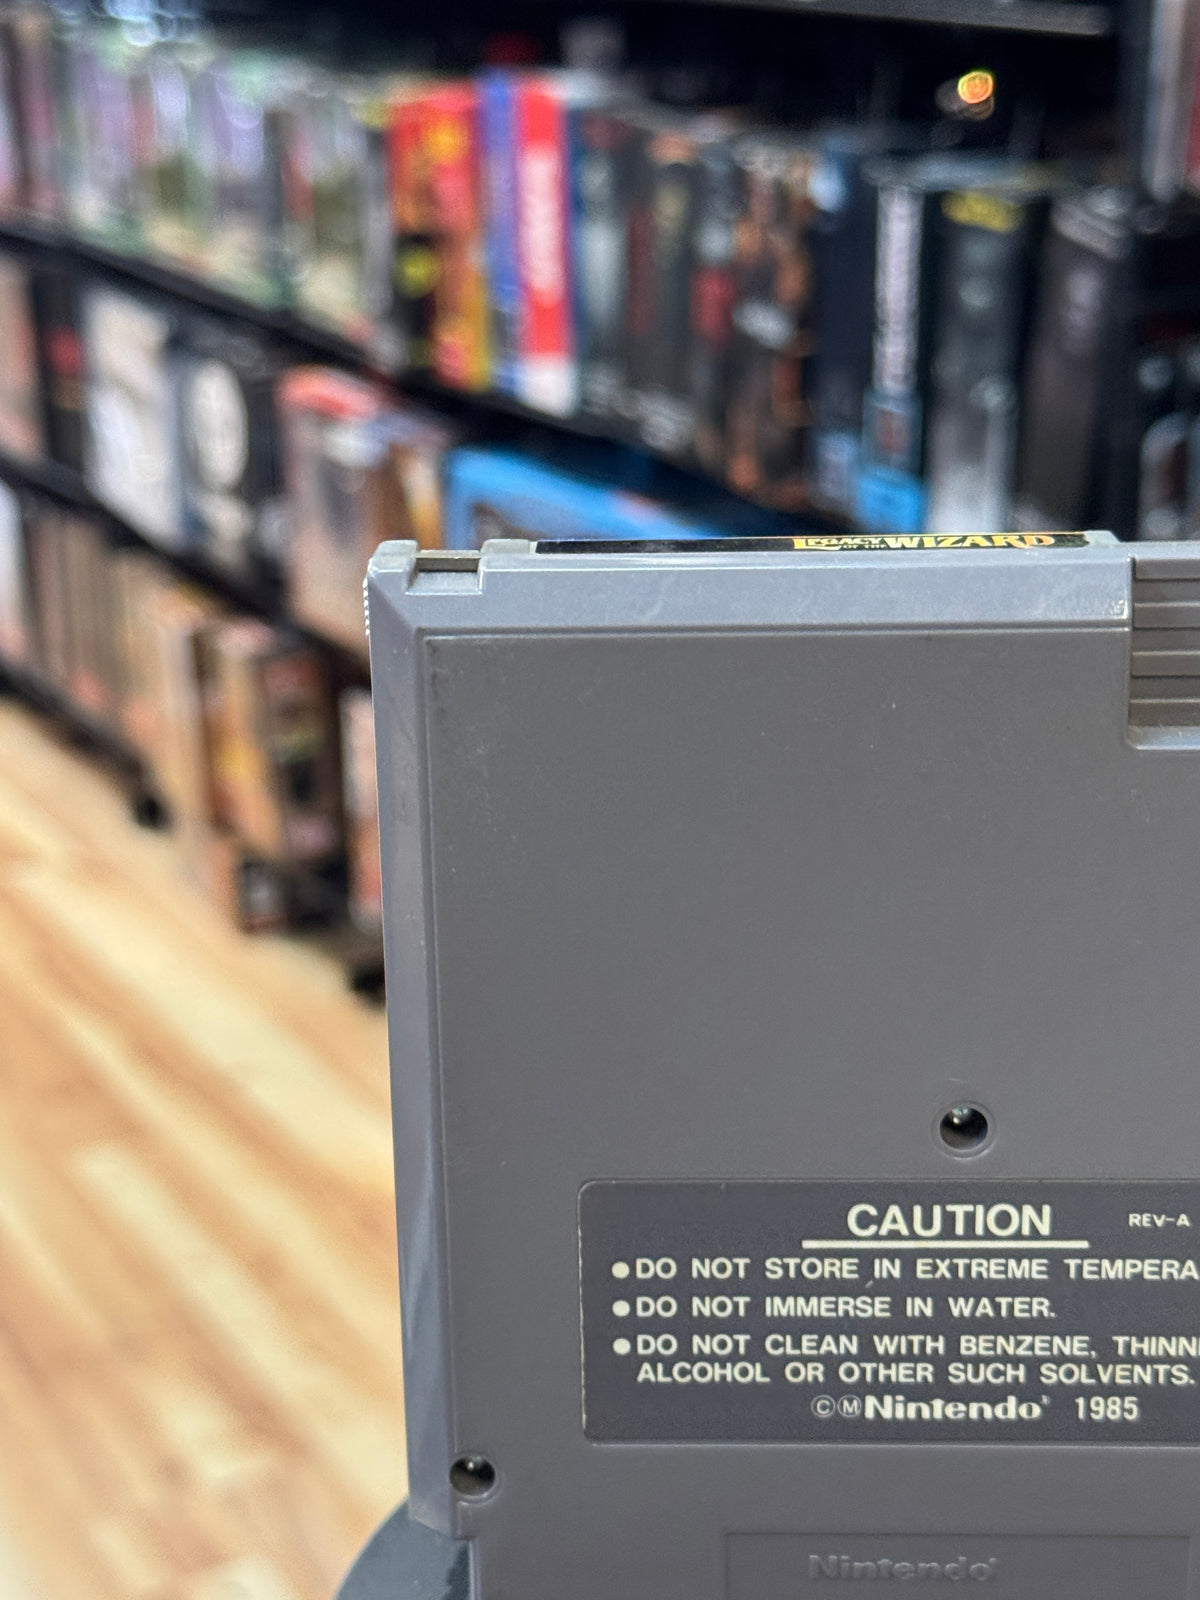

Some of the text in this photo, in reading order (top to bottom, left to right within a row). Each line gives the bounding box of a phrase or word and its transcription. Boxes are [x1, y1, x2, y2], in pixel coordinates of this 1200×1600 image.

[884, 535, 1055, 549] WIZARD
[847, 1204, 1051, 1237] CAUTION
[1129, 1213, 1191, 1227] REV-A
[636, 1258, 677, 1279] DO
[692, 1257, 750, 1279] NOT
[765, 1258, 859, 1279] STORE
[874, 1258, 901, 1278] IN
[917, 1258, 1048, 1279] EXTREME
[637, 1296, 1055, 1317] DO NOT IMMERSE IN WATER.
[637, 1334, 1200, 1358] DO NOT CLEAN WITH BENZENE, THINN
[637, 1362, 1195, 1385] ALCOHOL OR OTHER SUCH SOLVENTS.
[1075, 1396, 1138, 1420] 1985
